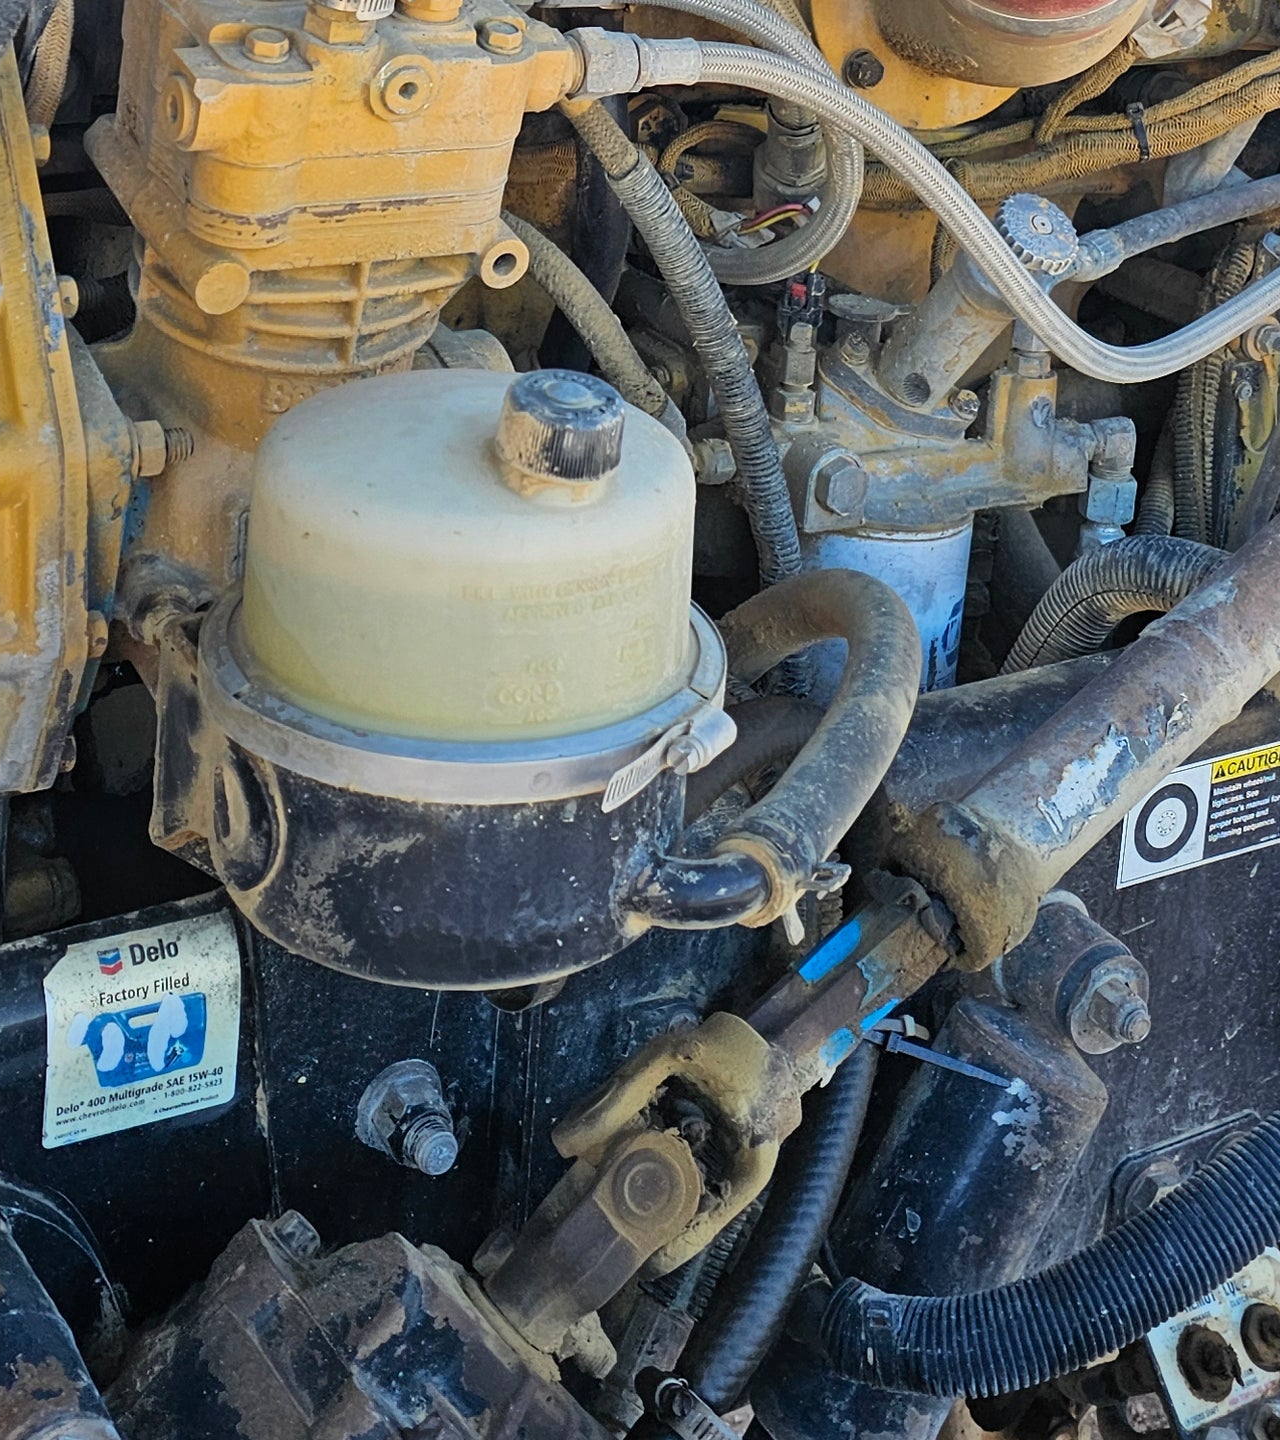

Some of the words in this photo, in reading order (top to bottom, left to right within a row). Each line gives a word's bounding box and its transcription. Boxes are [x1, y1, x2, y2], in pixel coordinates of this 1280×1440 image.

[99, 985, 150, 1007] Factory
[153, 972, 191, 993] Filled
[87, 1096, 106, 1108] 400
[108, 1080, 164, 1104] Multigrade
[166, 1075, 186, 1090] SAE
[188, 1066, 224, 1083] 15W-40
